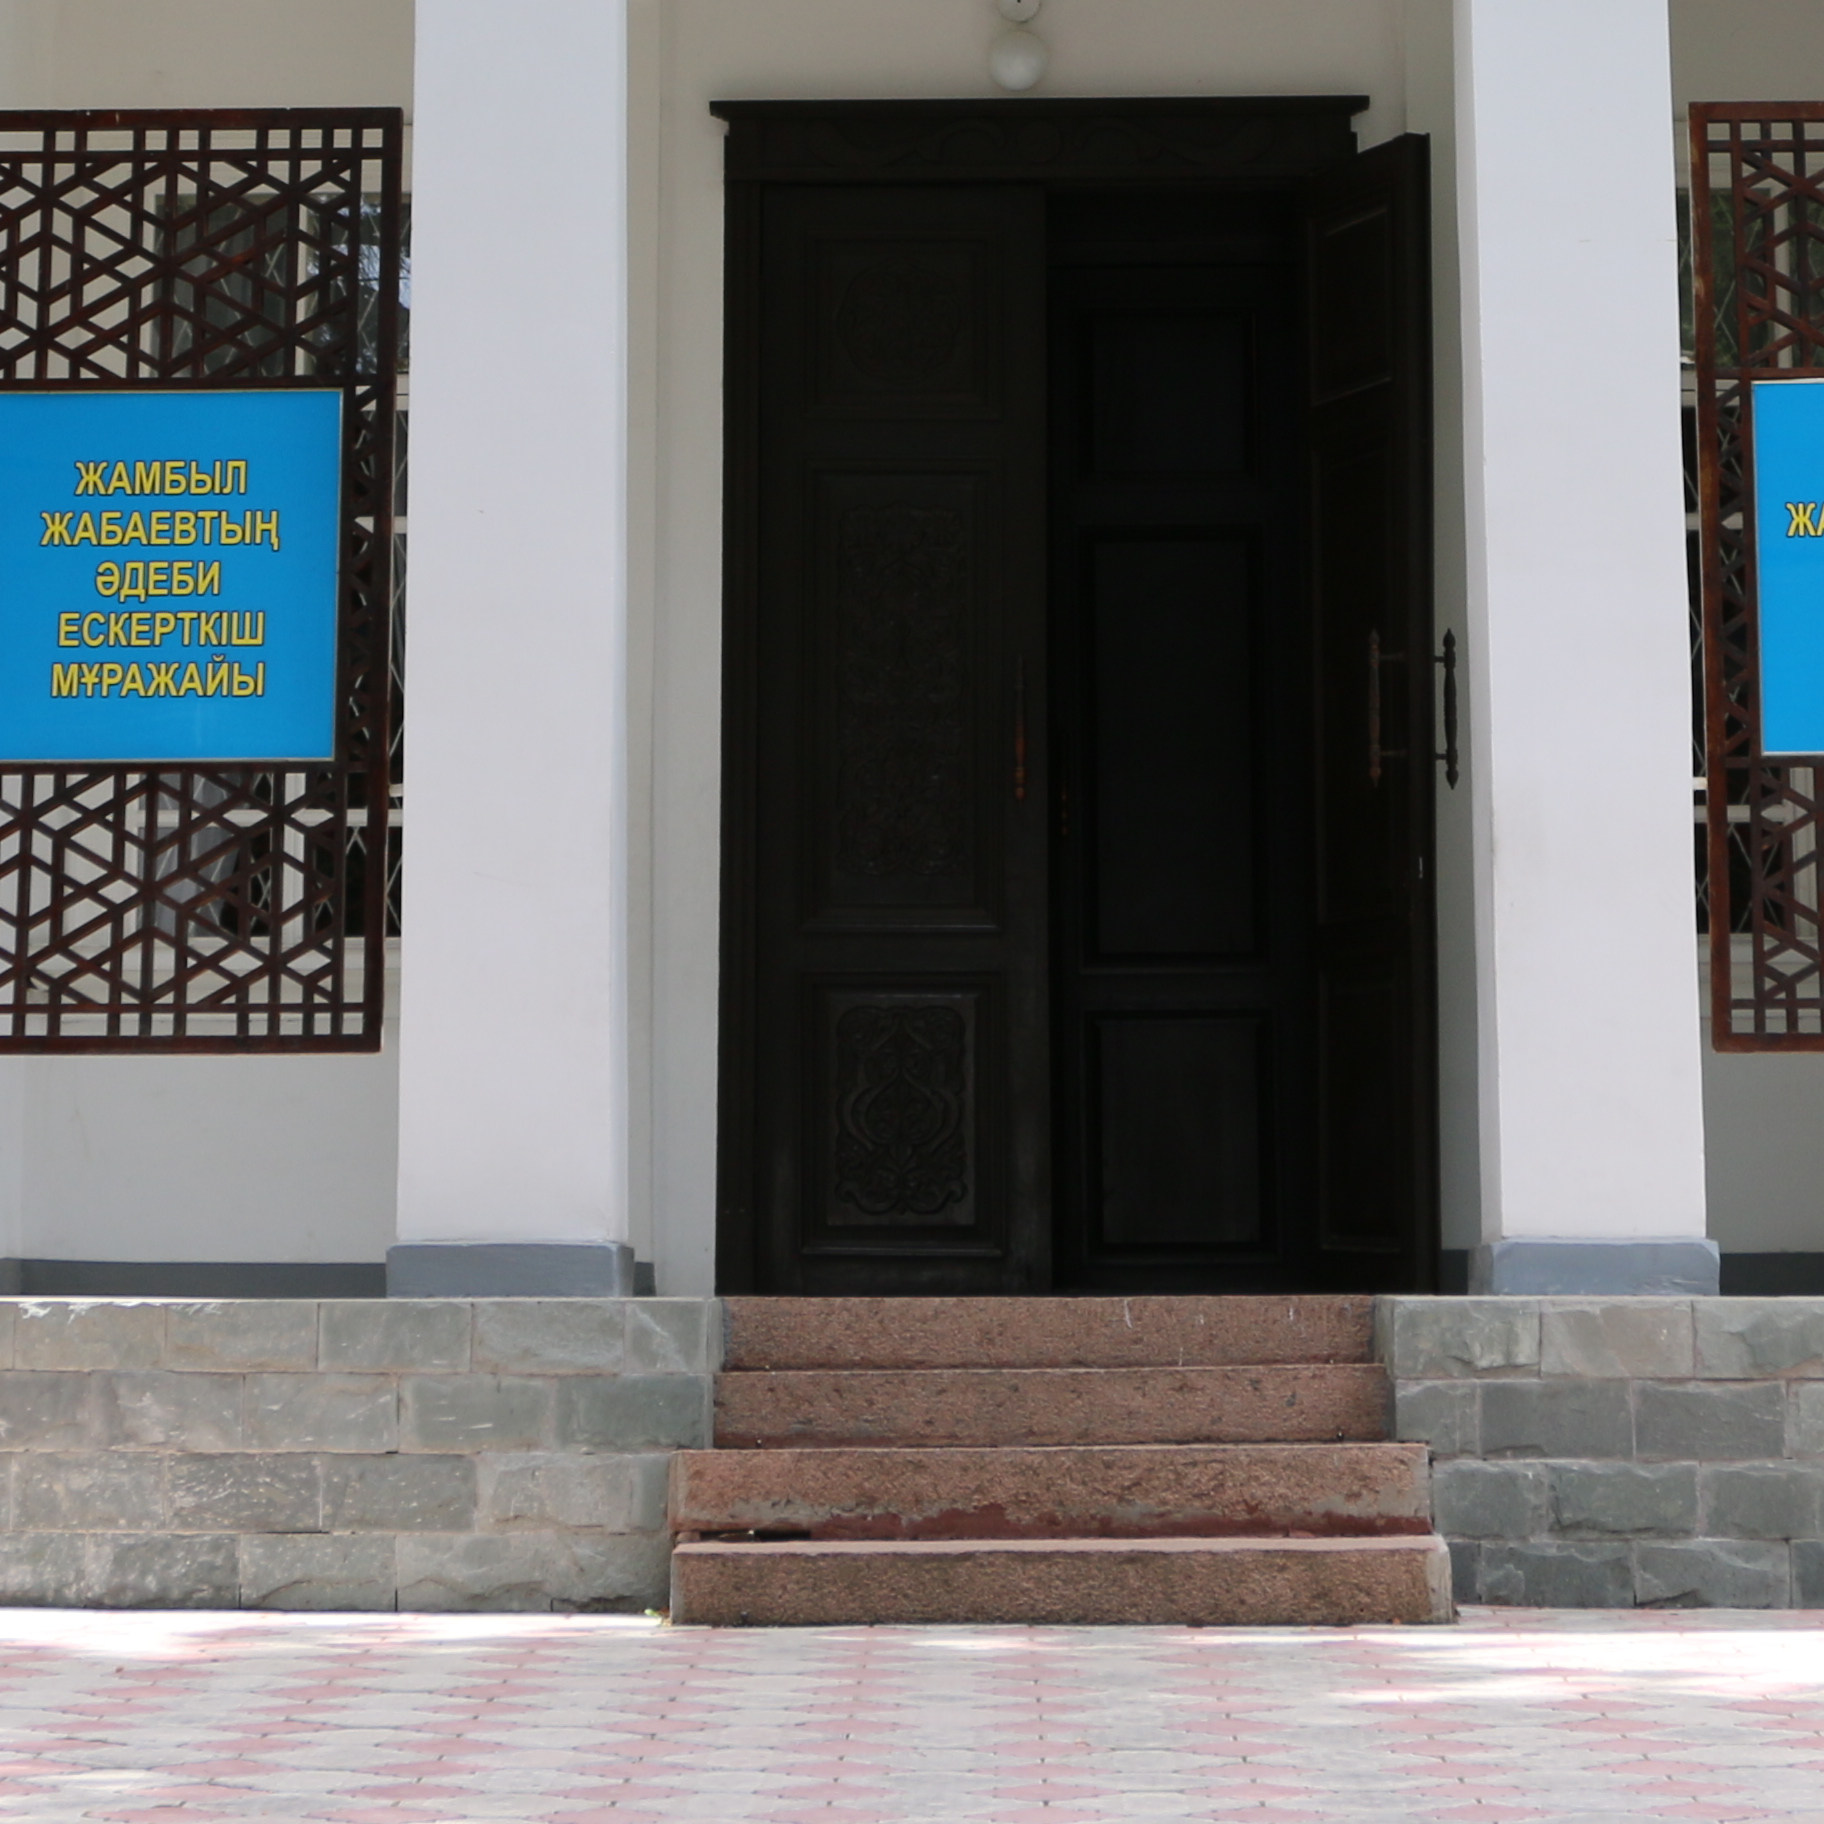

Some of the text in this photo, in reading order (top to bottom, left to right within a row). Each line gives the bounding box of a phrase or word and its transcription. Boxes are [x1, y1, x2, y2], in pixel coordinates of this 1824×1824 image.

[75, 460, 247, 495] ЖАМБЫЛ
[40, 510, 279, 551] ЖАБАЕВТЫҢ
[95, 561, 221, 602] ӘДЕБИ
[58, 611, 265, 646] ЕСКЕРТКІШ
[51, 655, 265, 697] МҰРАЖАЙЫ
